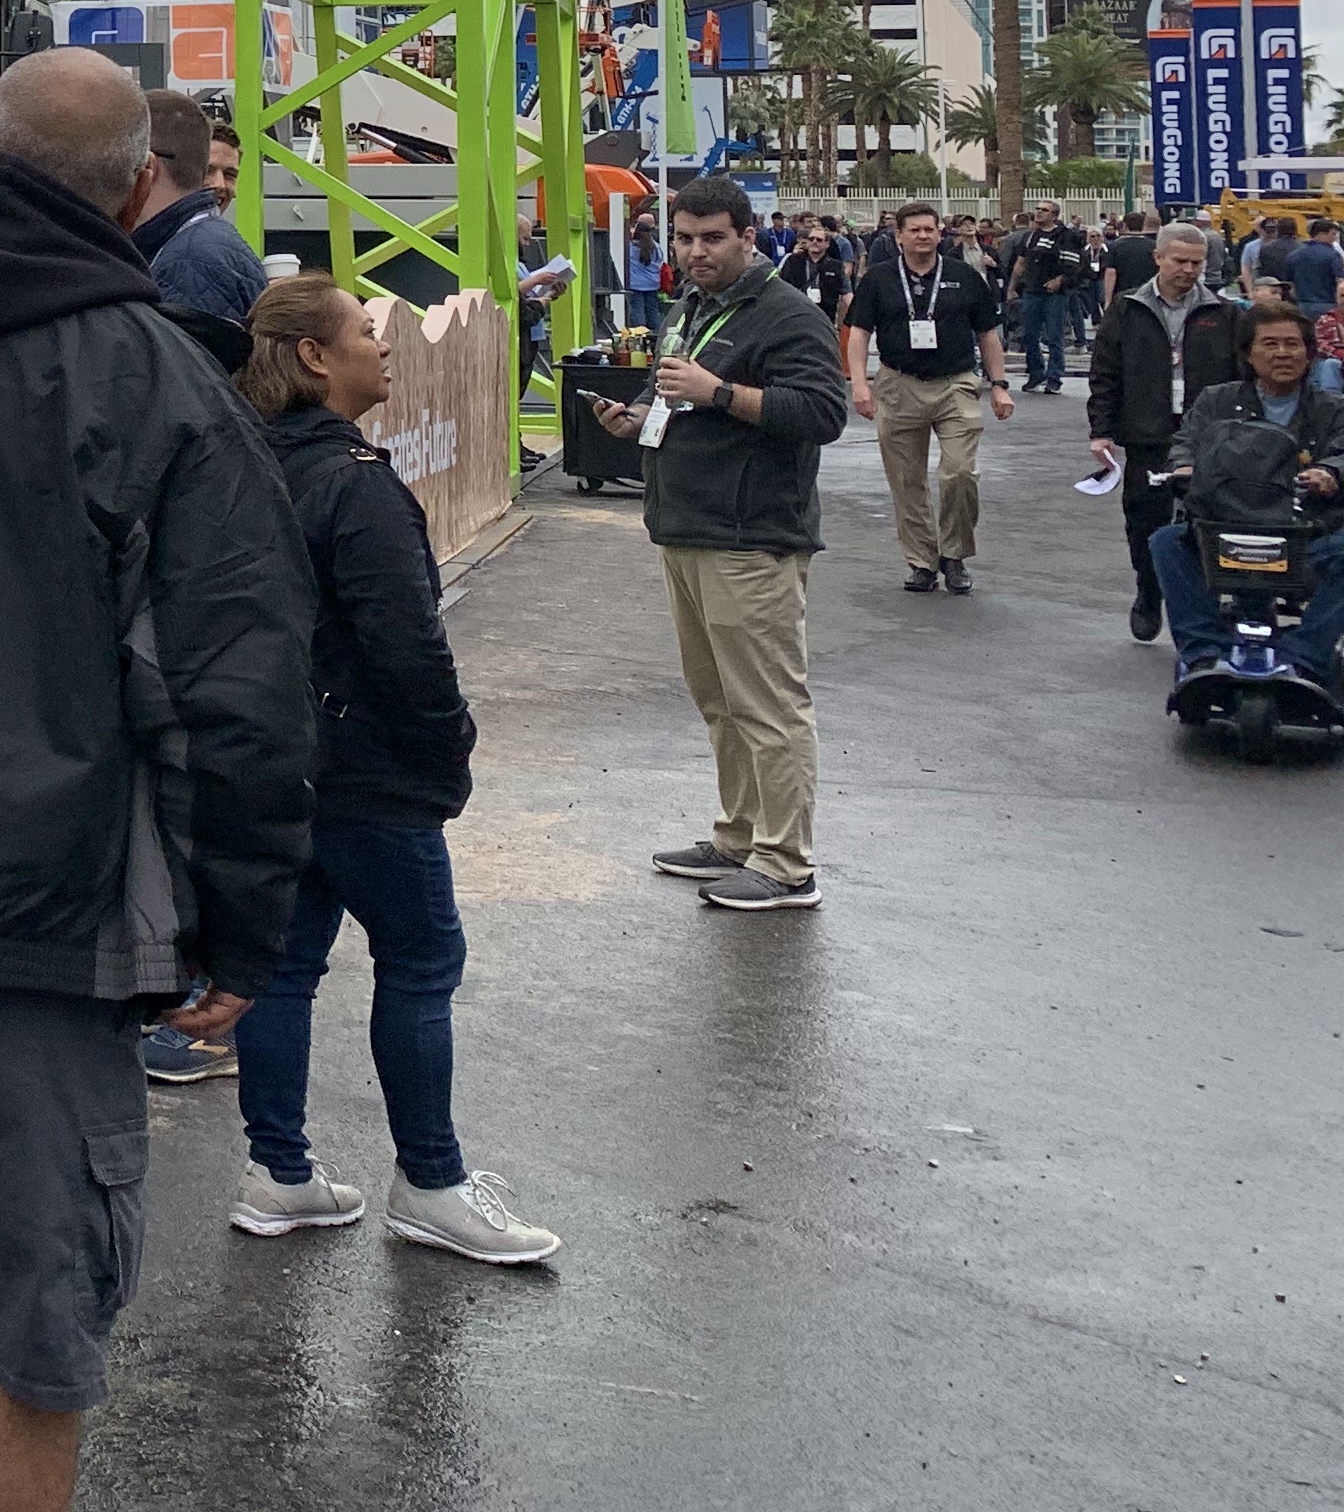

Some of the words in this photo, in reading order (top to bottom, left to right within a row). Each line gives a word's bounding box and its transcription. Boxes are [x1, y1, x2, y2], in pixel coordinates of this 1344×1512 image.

[1162, 91, 1183, 194] LIUGONG
[1207, 68, 1231, 188] LIUGONG
[1267, 68, 1292, 190] LIUGOG
[421, 408, 456, 478] Future
